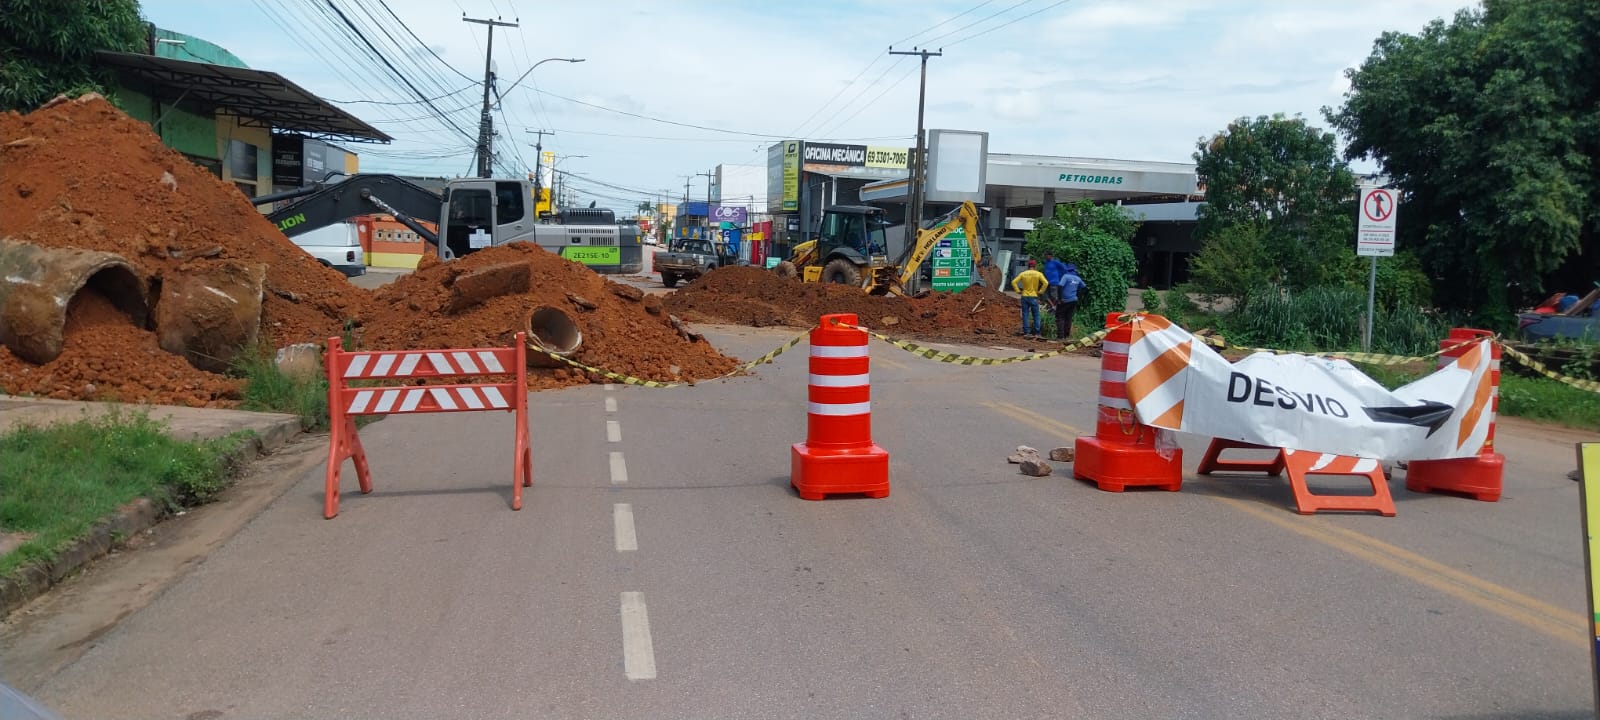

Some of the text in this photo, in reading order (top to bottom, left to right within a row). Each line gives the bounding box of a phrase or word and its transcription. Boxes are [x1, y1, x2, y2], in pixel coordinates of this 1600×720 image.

[805, 146, 865, 163] OFICINA MECÂNICA
[867, 151, 875, 163] 69
[876, 152, 907, 164] 3301-7005
[1058, 173, 1123, 185] PETROBRAS
[924, 227, 947, 250] HOLLAND
[1226, 371, 1350, 419] DESVIO
